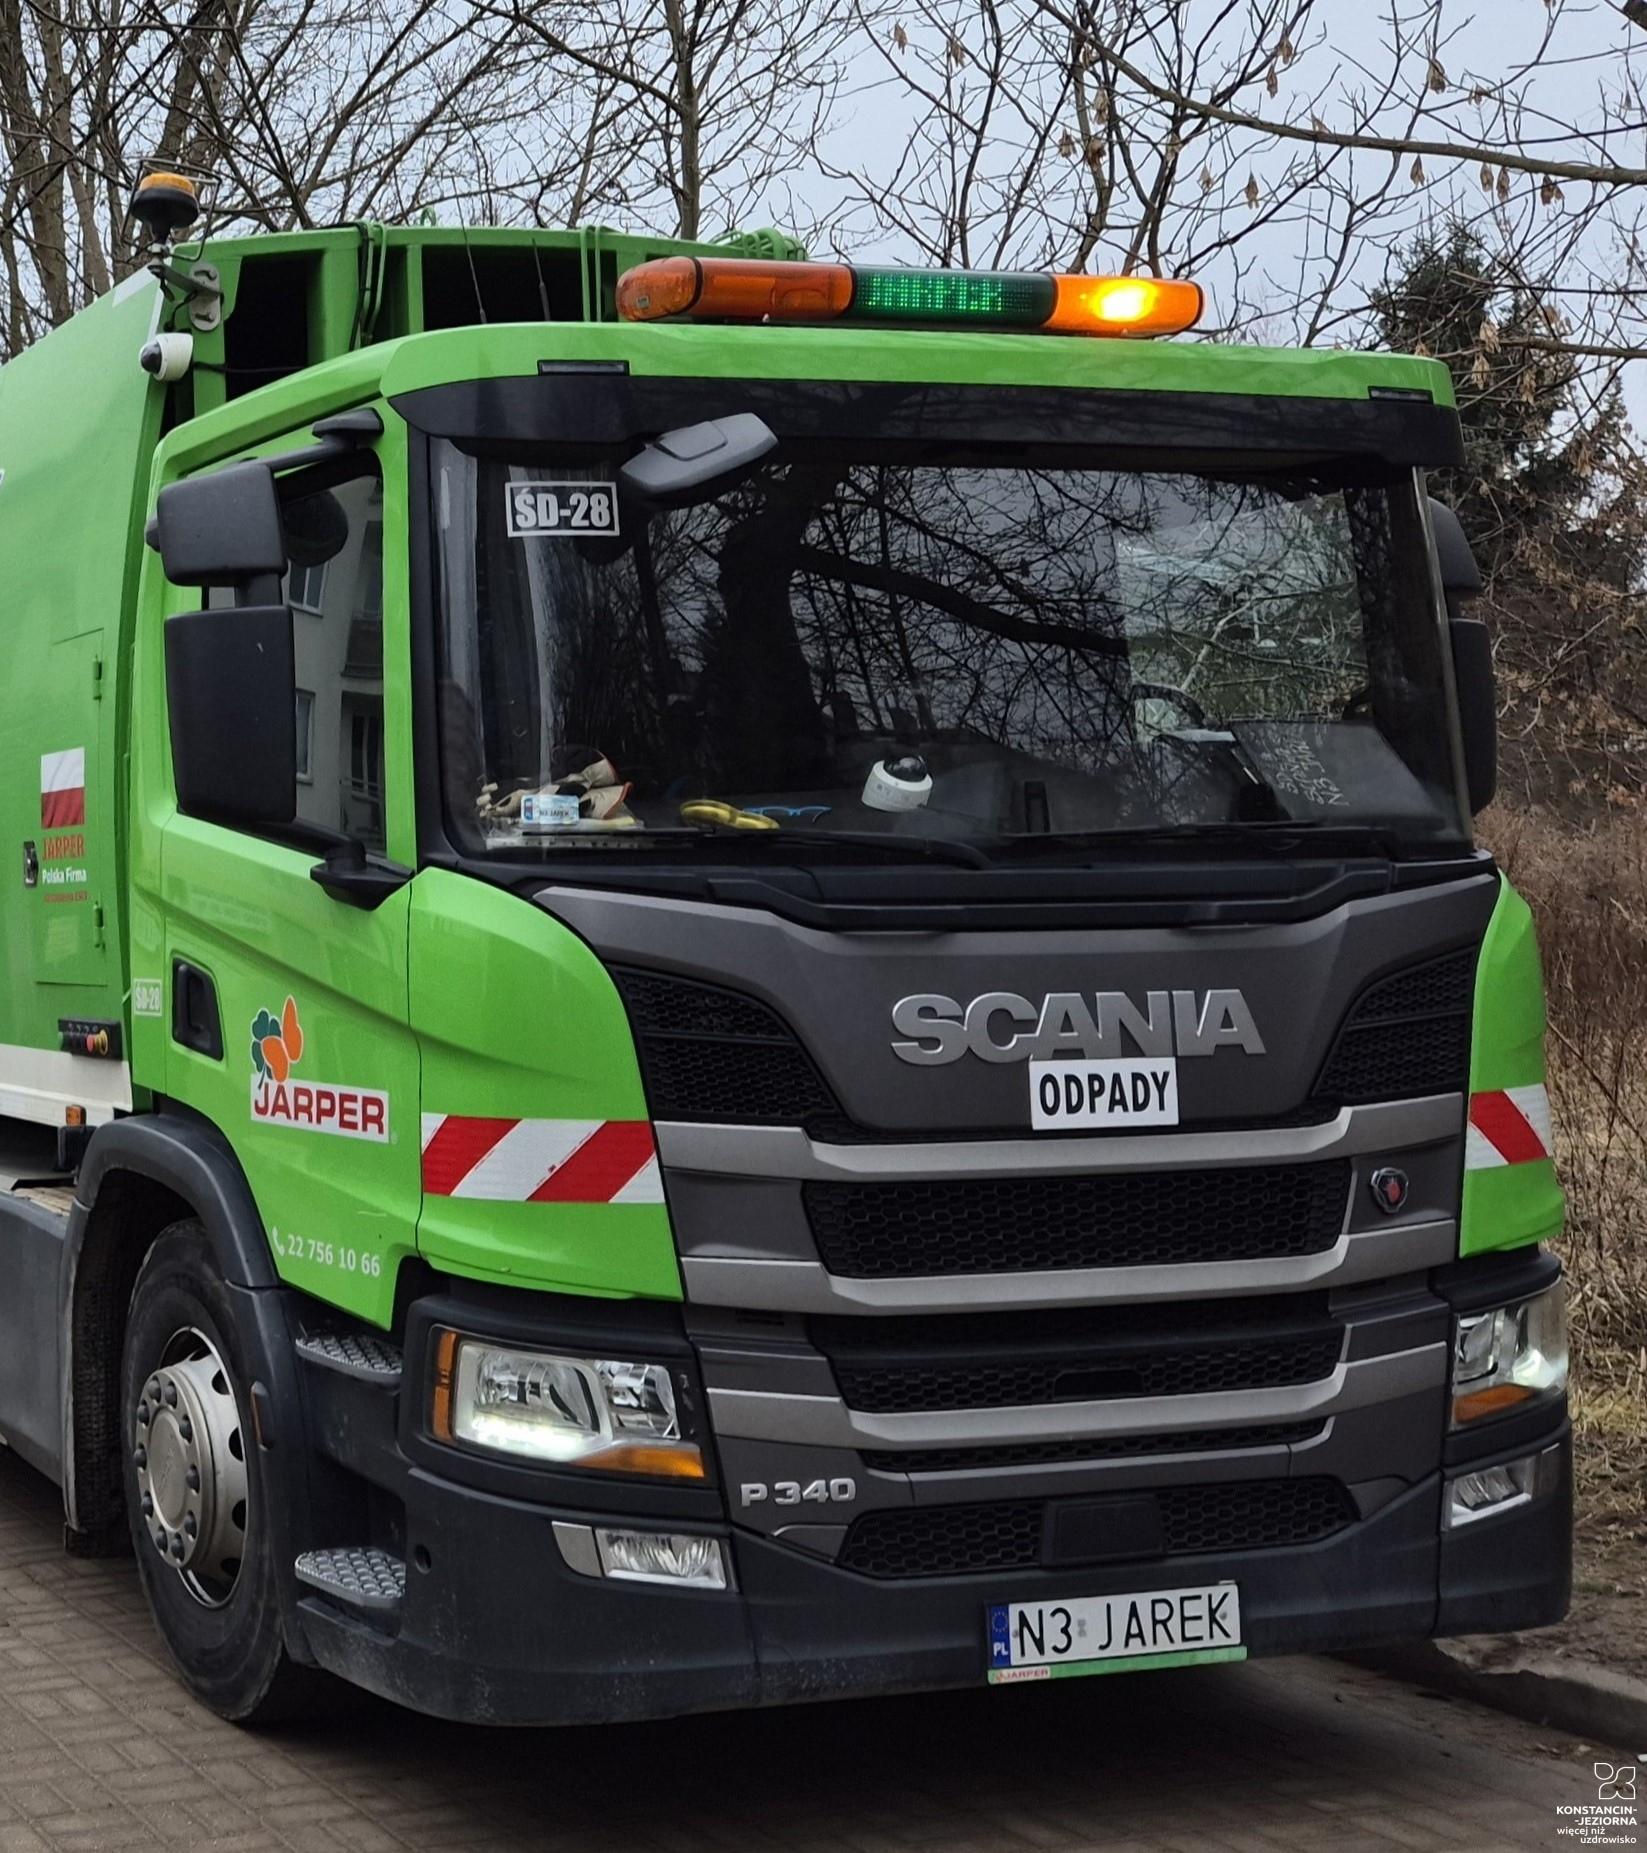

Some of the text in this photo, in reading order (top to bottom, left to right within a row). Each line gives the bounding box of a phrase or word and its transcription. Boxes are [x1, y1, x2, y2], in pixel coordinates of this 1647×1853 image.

[515, 487, 611, 528] ŚD-28
[43, 834, 85, 860] JARPER
[42, 866, 87, 884] Polska Firma
[891, 988, 1266, 1066] SCANIA
[254, 1082, 385, 1135] JARPER
[1039, 1070, 1170, 1116] ODPADY
[287, 1234, 381, 1278] 22 756 10 66
[741, 1478, 856, 1507] P 340
[993, 1591, 1232, 1658] PL N3 JAREK
[1007, 1669, 1048, 1679] JARPER
